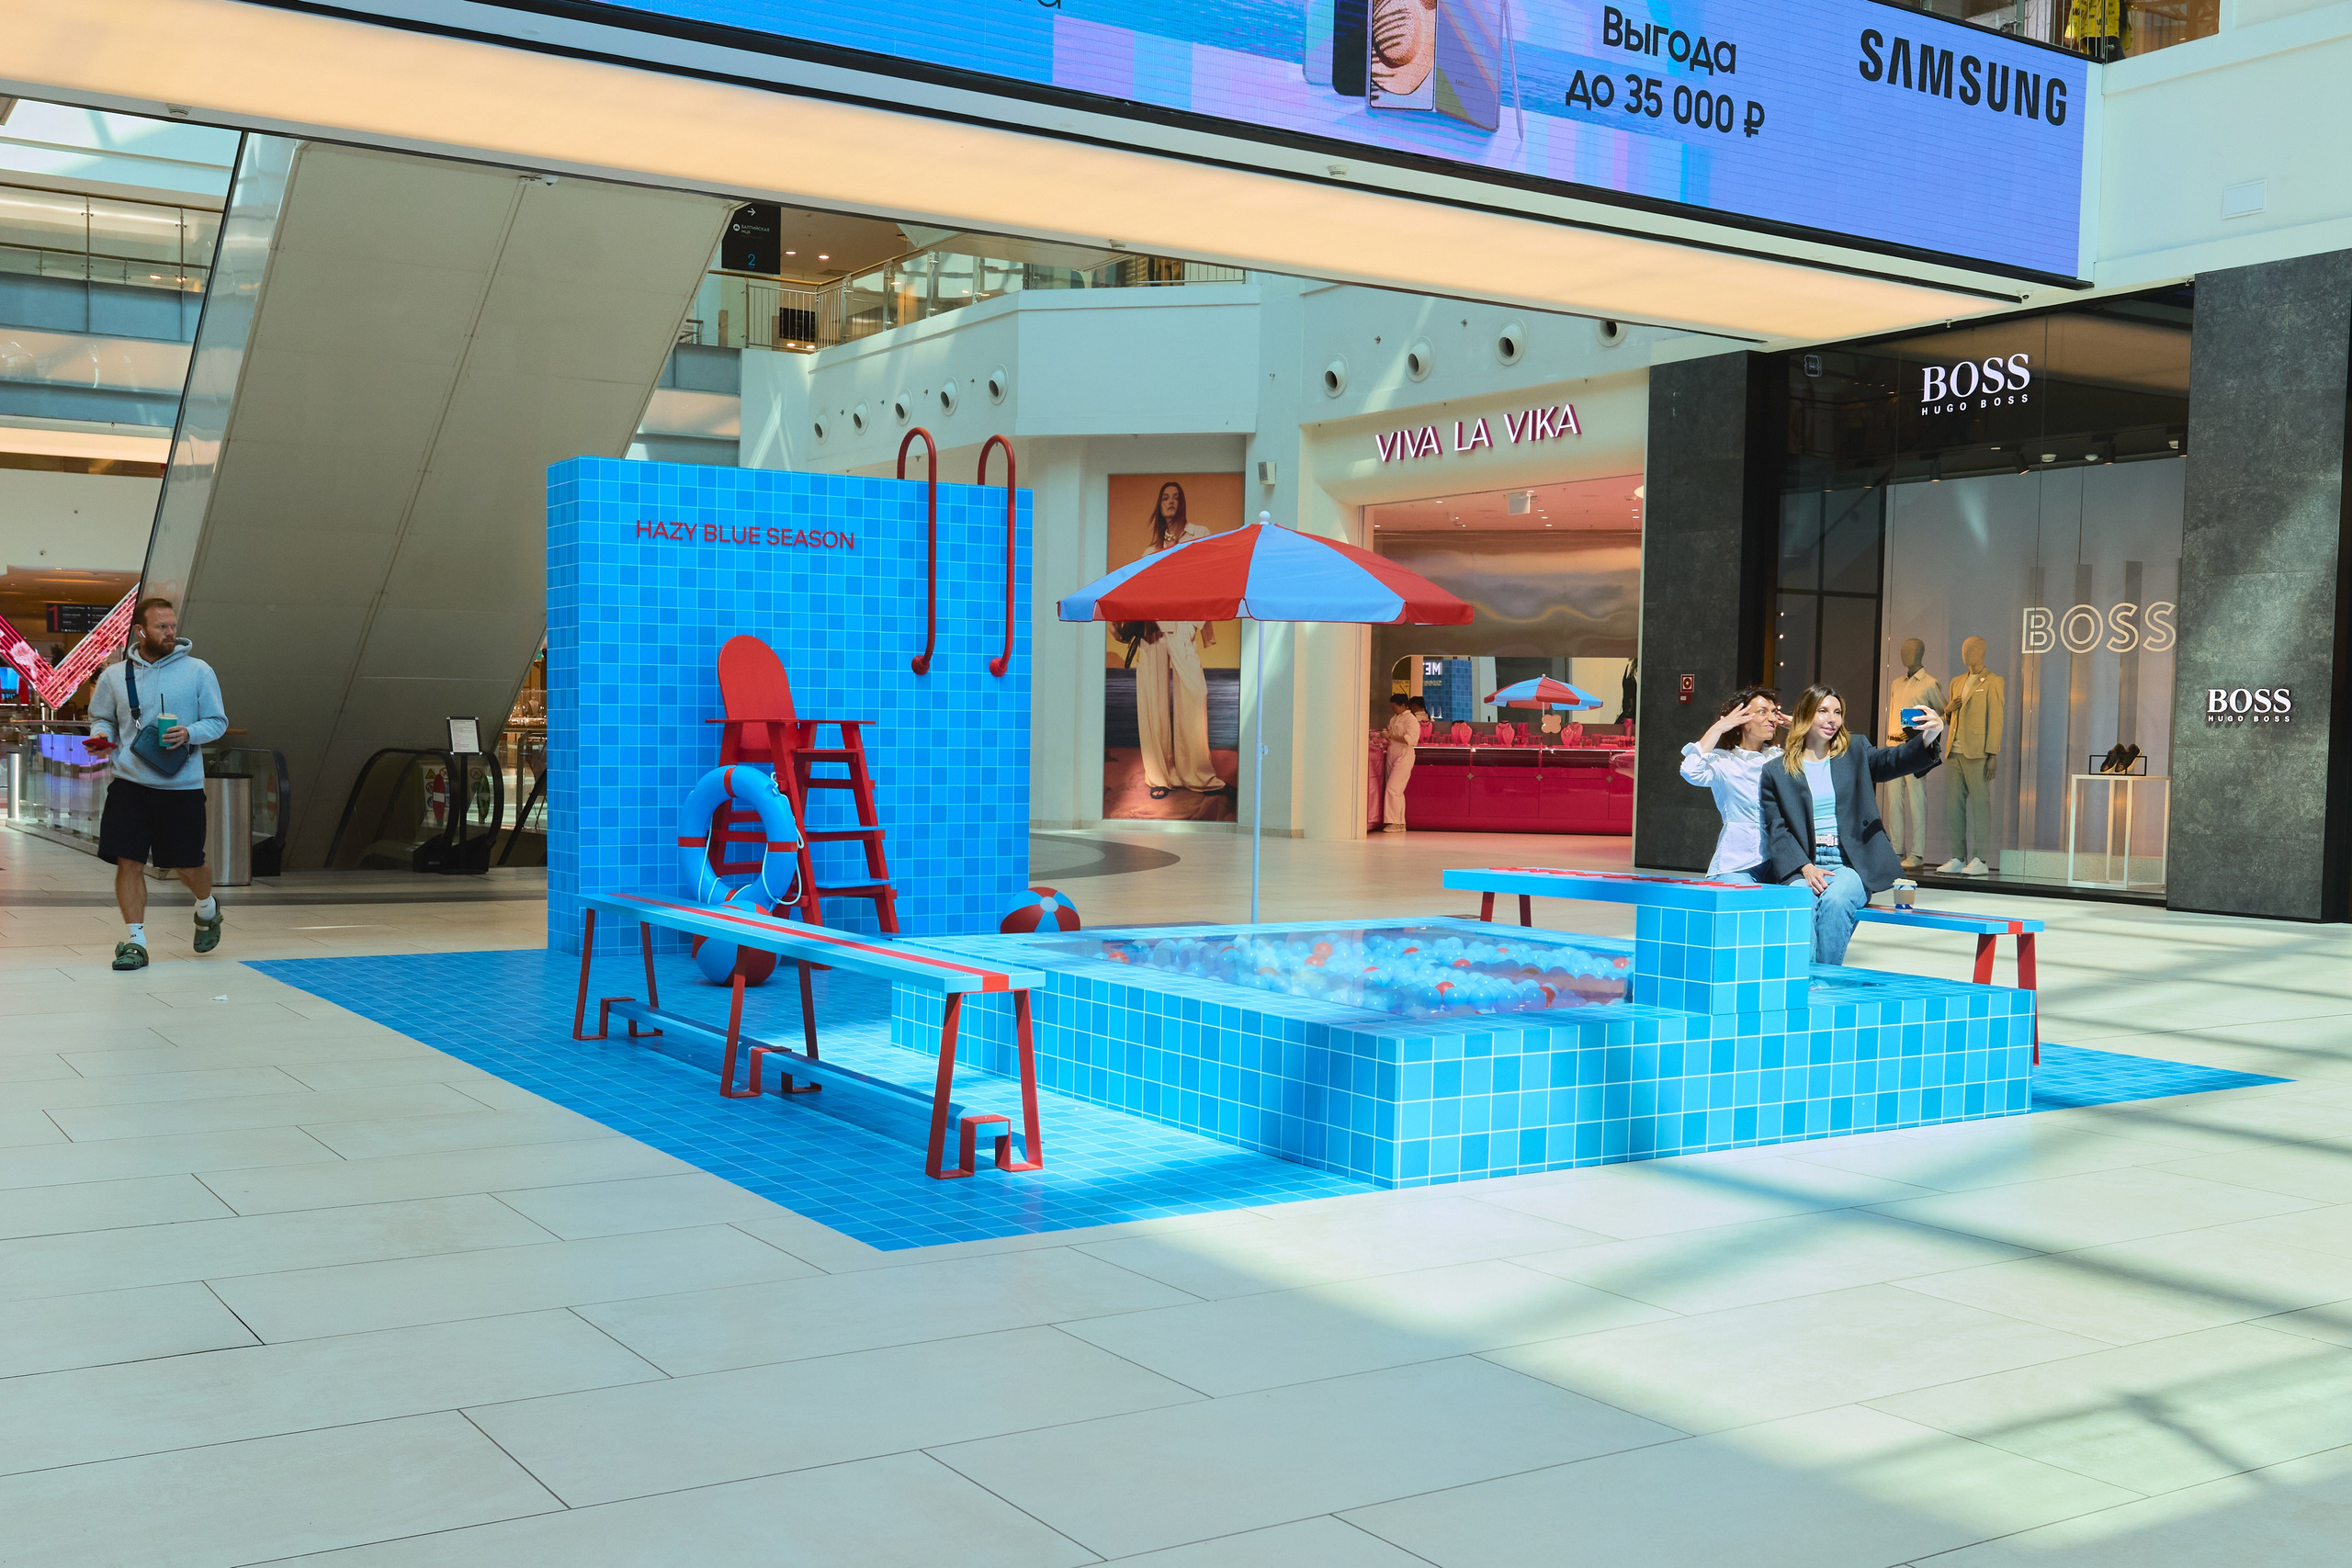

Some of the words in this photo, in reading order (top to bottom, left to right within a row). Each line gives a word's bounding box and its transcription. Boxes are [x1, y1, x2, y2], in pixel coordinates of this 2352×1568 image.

[1602, 5, 1736, 76] Выгода
[1859, 28, 2067, 127] SAMSUNG
[1565, 69, 1615, 111] до
[1623, 73, 1663, 118] 35
[1673, 85, 1735, 133] 000
[748, 254, 756, 265] 2
[1921, 353, 2031, 402] BOSS
[1921, 401, 1968, 416] HUGO
[1980, 393, 2030, 409] BOSS
[1375, 425, 1442, 462] VIVA
[1454, 418, 1493, 451] LA
[1504, 403, 1581, 444] VIKA
[636, 520, 697, 540] HAZY
[704, 524, 761, 544] BLUE
[766, 527, 854, 549] SEASON
[48, 604, 58, 631] 1
[2021, 601, 2177, 654] BOSS
[2207, 688, 2292, 714] BOSS
[2208, 715, 2245, 723] HUGO
